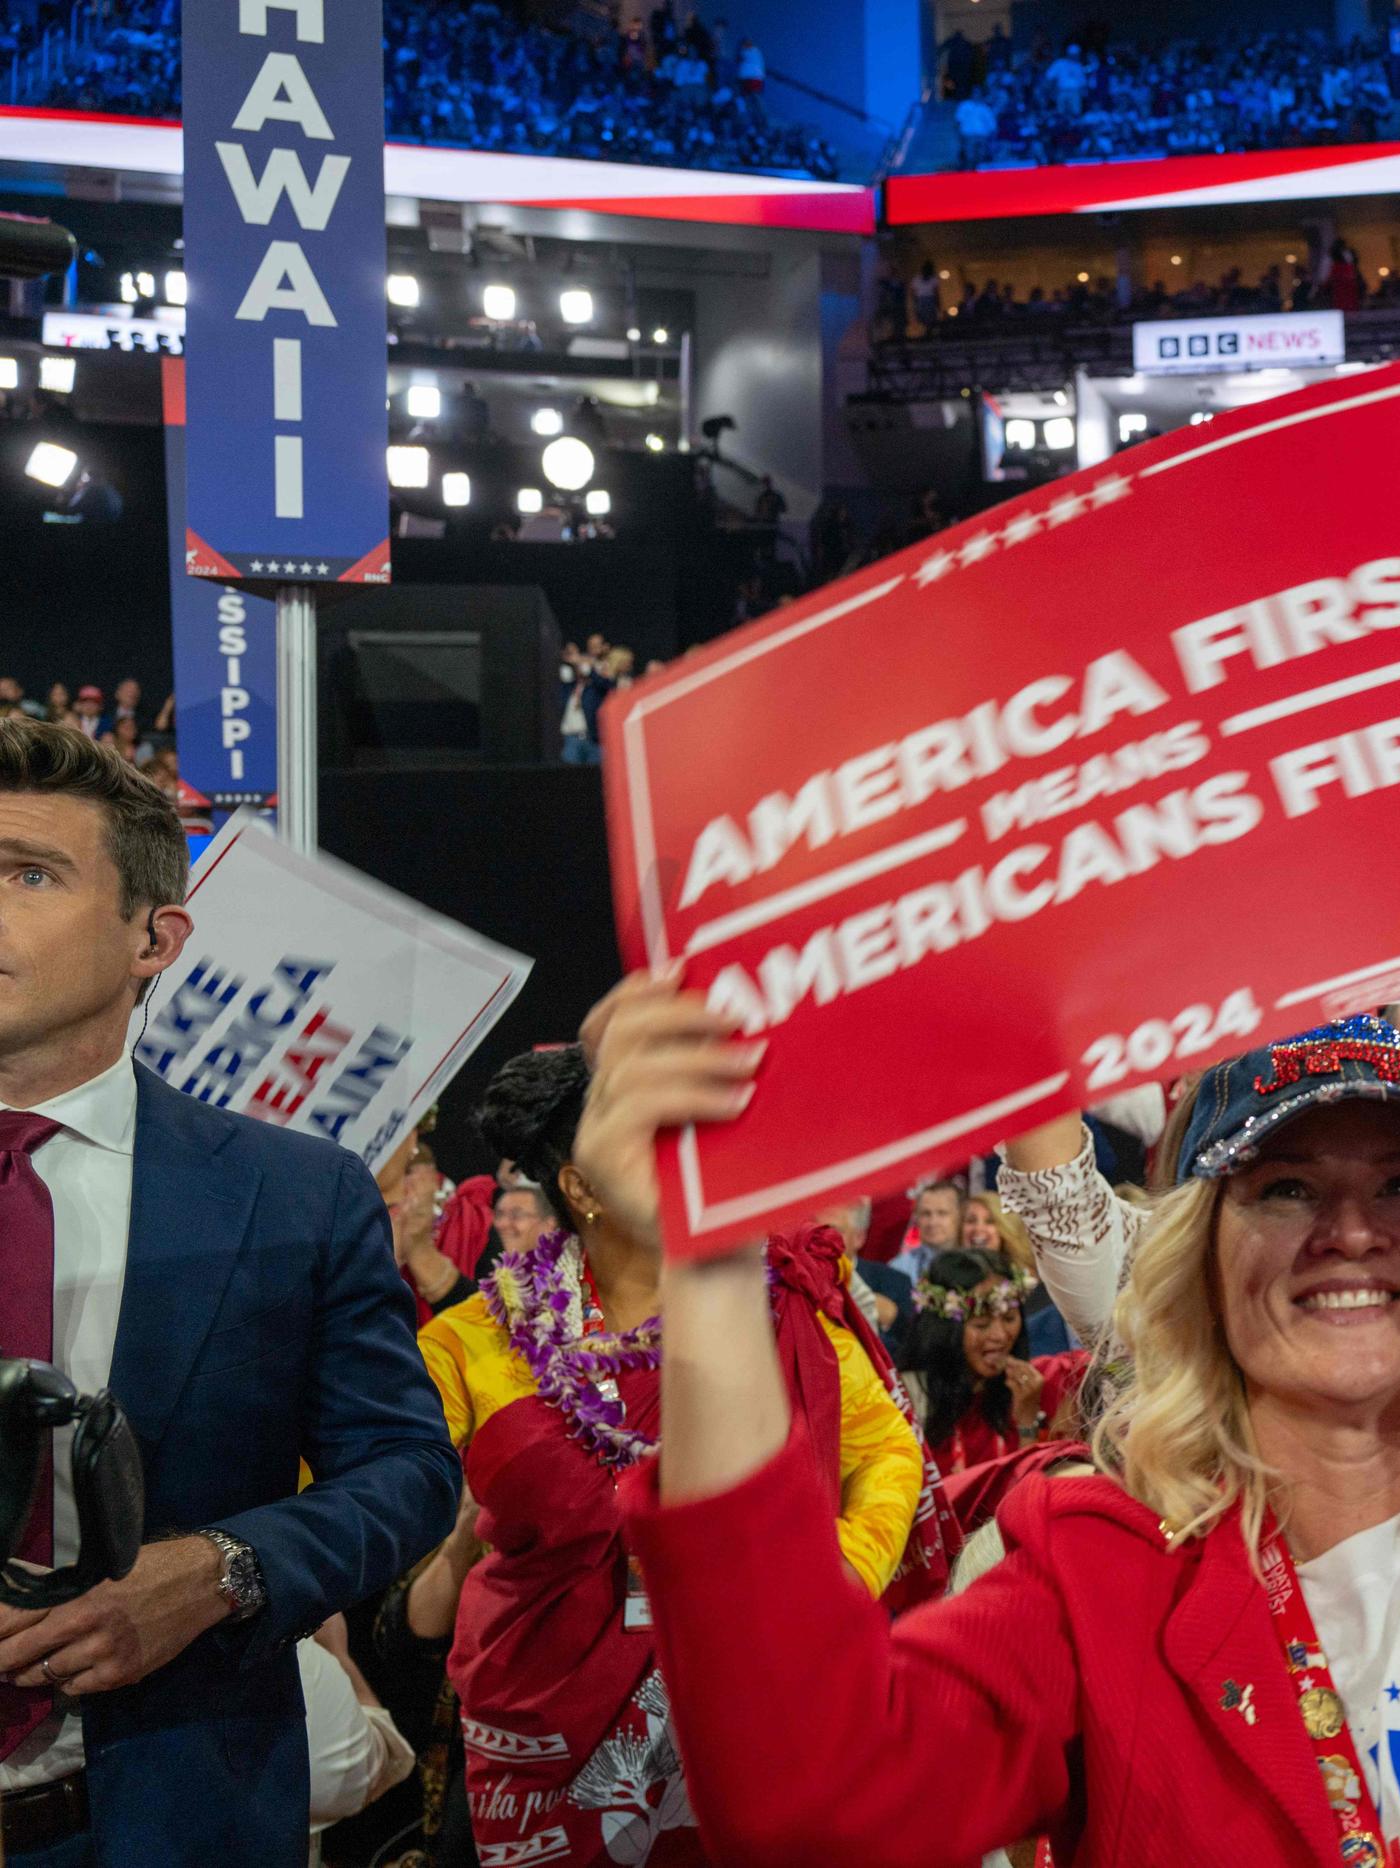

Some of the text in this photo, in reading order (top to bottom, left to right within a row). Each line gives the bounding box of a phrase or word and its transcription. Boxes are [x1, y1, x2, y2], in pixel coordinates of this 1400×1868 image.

[1159, 329, 1320, 358] BBC NEWS
[363, 572, 388, 583] RNC
[217, 584, 251, 780] SSIPPI
[678, 647, 1170, 911] AMERICA
[980, 719, 1210, 842] MEANS
[704, 770, 1264, 1037] AMERICANS
[138, 955, 248, 1080] AKE
[1081, 986, 1262, 1090] 2024
[1271, 1561, 1294, 1603] DATA
